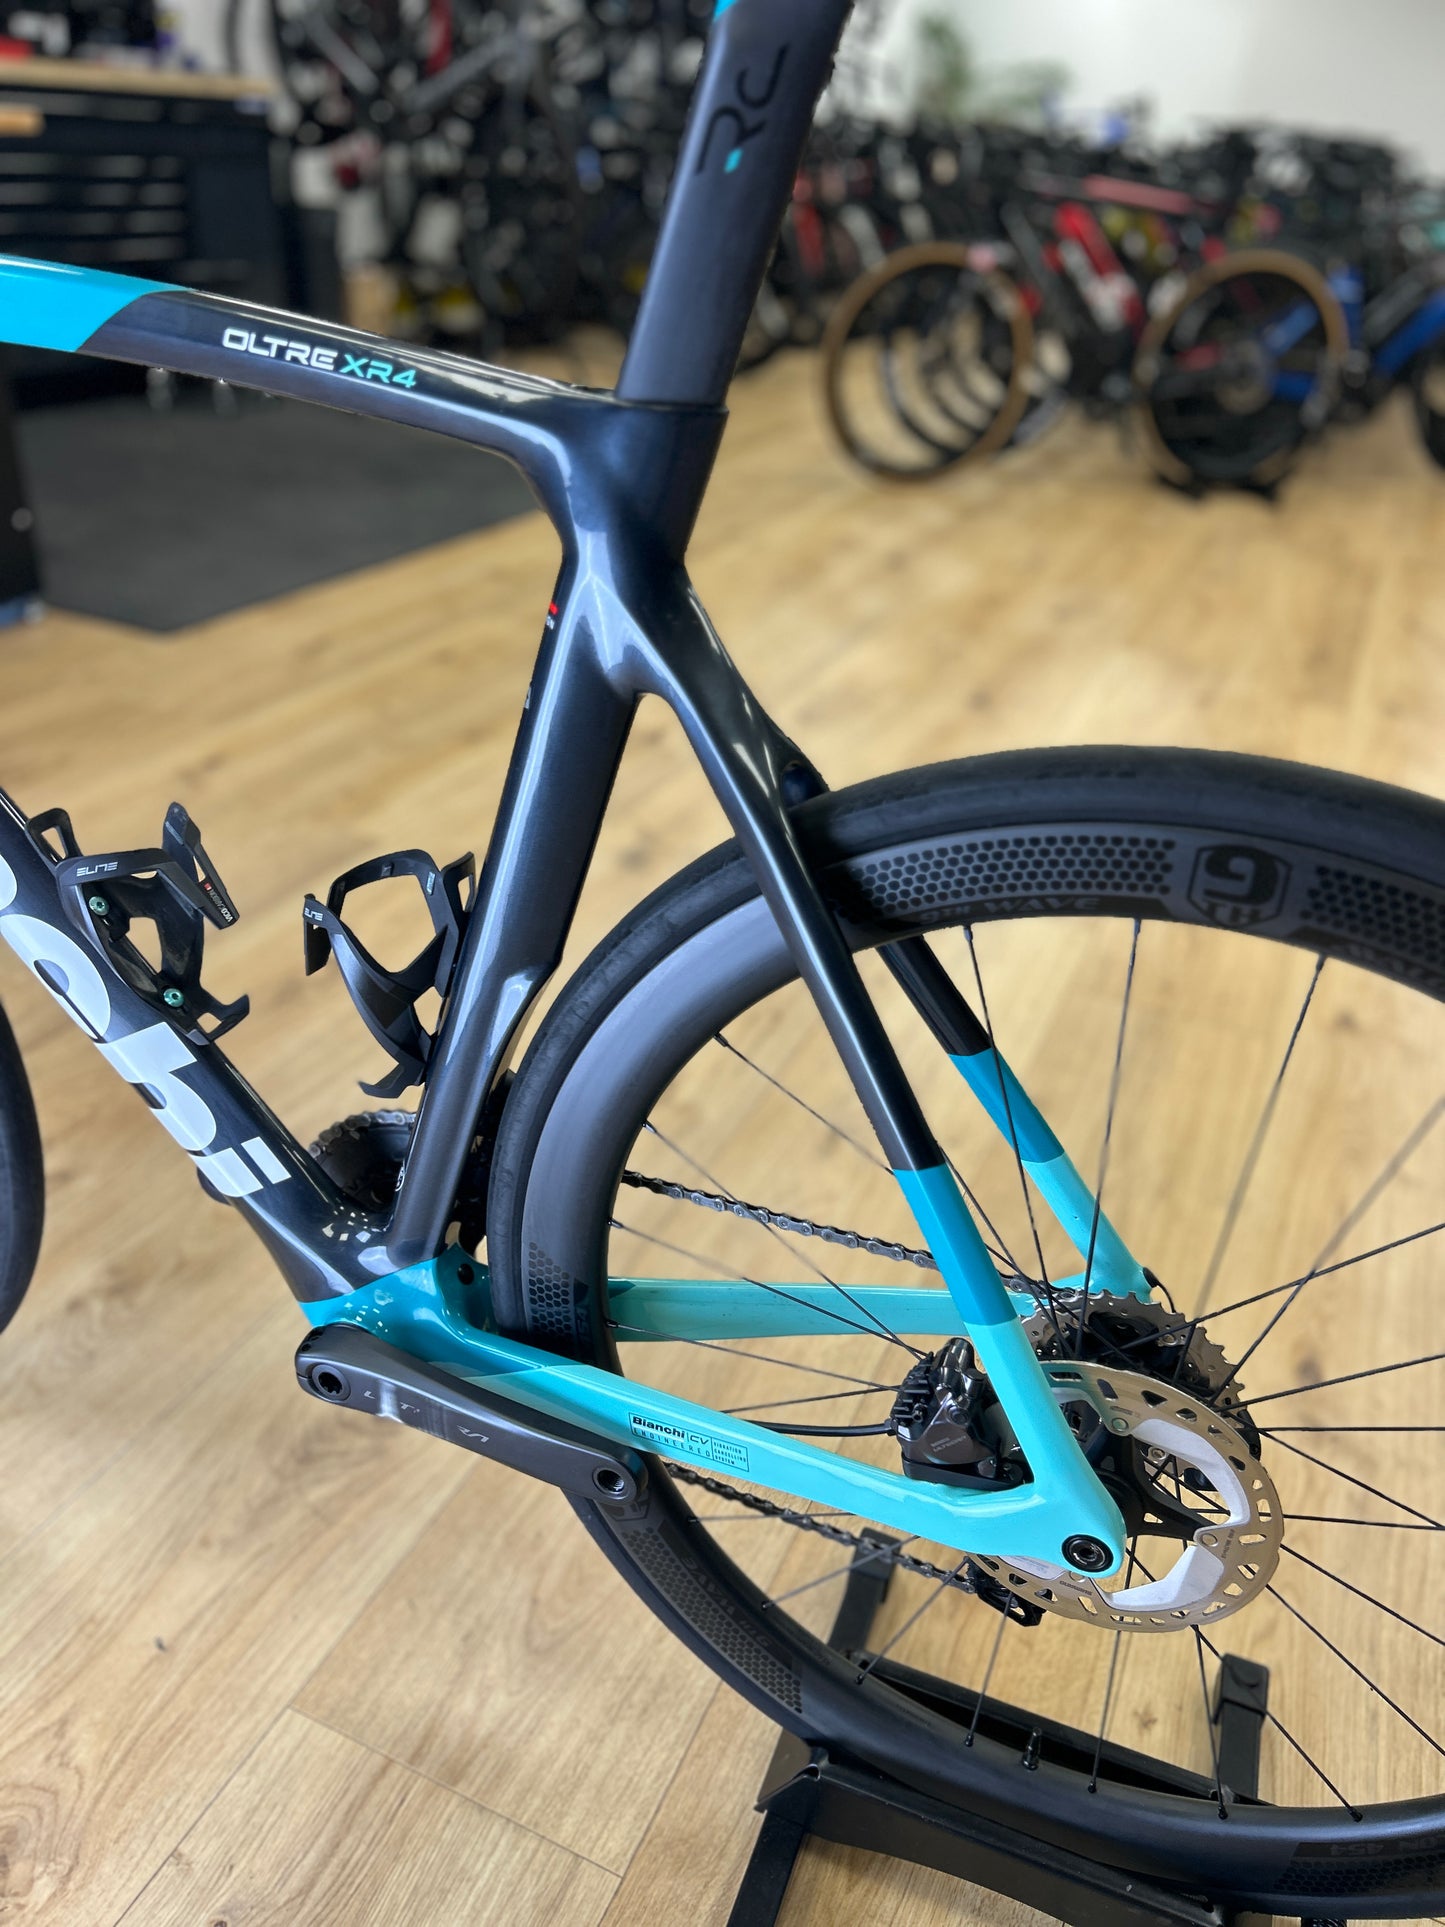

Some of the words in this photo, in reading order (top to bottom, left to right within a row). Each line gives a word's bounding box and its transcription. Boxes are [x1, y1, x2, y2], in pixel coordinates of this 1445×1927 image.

[222, 326, 338, 372] OLTRE
[339, 353, 417, 388] XR4
[76, 861, 118, 877] ELITE
[984, 897, 1099, 913] WAVE
[632, 1415, 686, 1439] Bianchi
[690, 1434, 710, 1445] CV
